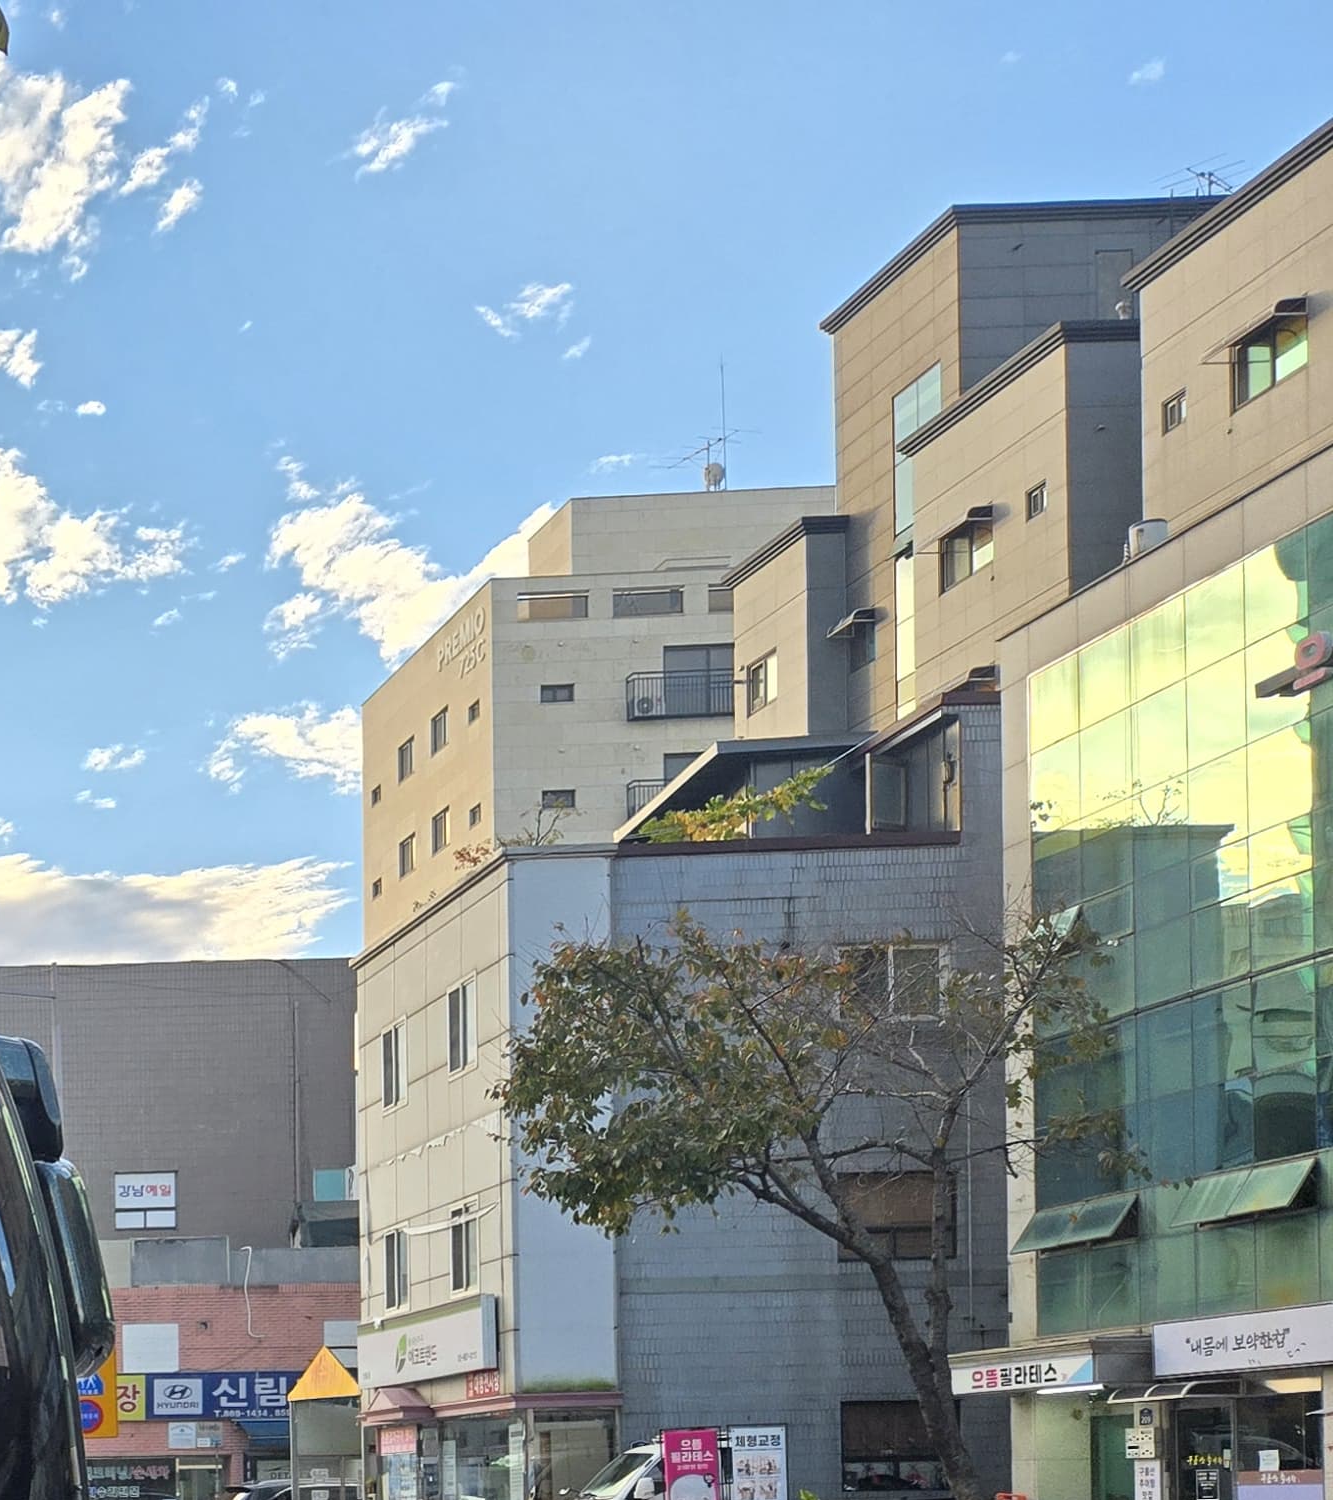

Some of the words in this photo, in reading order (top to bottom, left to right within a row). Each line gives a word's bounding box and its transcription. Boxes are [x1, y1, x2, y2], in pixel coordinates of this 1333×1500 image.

[212, 1376, 287, 1407] 신림
[157, 1401, 199, 1409] HYUNDAI
[735, 1434, 781, 1448] 체형교정
